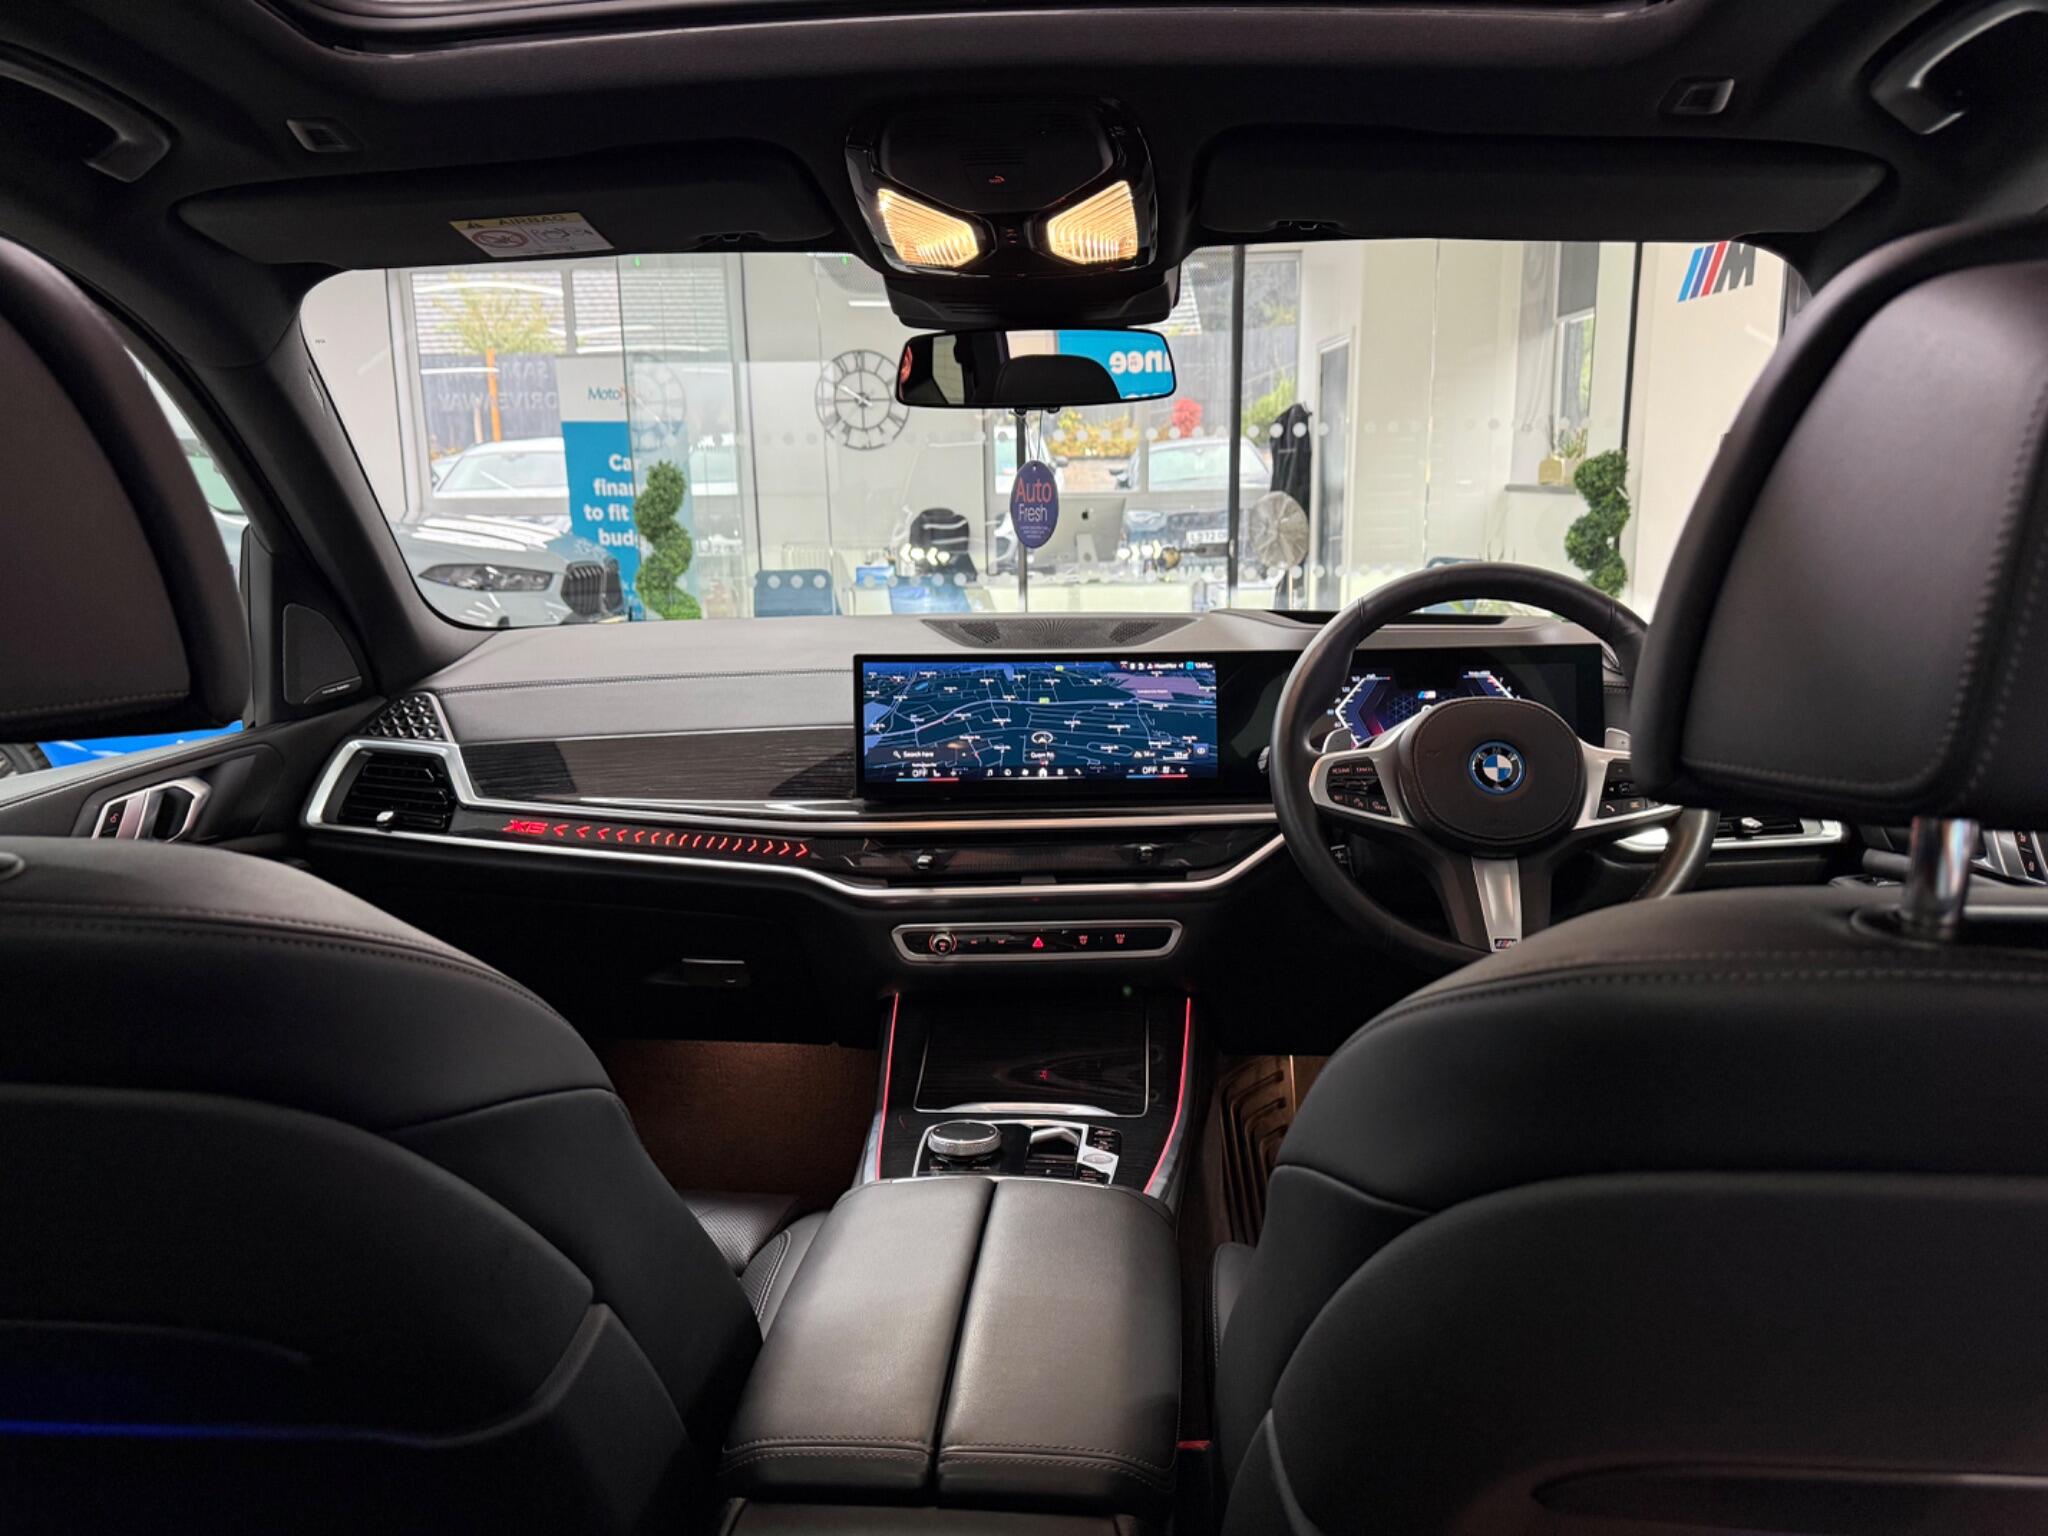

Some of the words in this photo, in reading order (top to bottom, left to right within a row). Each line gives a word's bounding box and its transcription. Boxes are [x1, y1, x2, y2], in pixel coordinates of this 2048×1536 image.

[499, 214, 567, 226] AIRBAG
[1015, 478, 1053, 503] Auto
[583, 504, 604, 521] to
[608, 503, 629, 521] fit
[1018, 503, 1048, 522] Fresh
[911, 768, 928, 778] OFF
[1142, 766, 1157, 775] OFF
